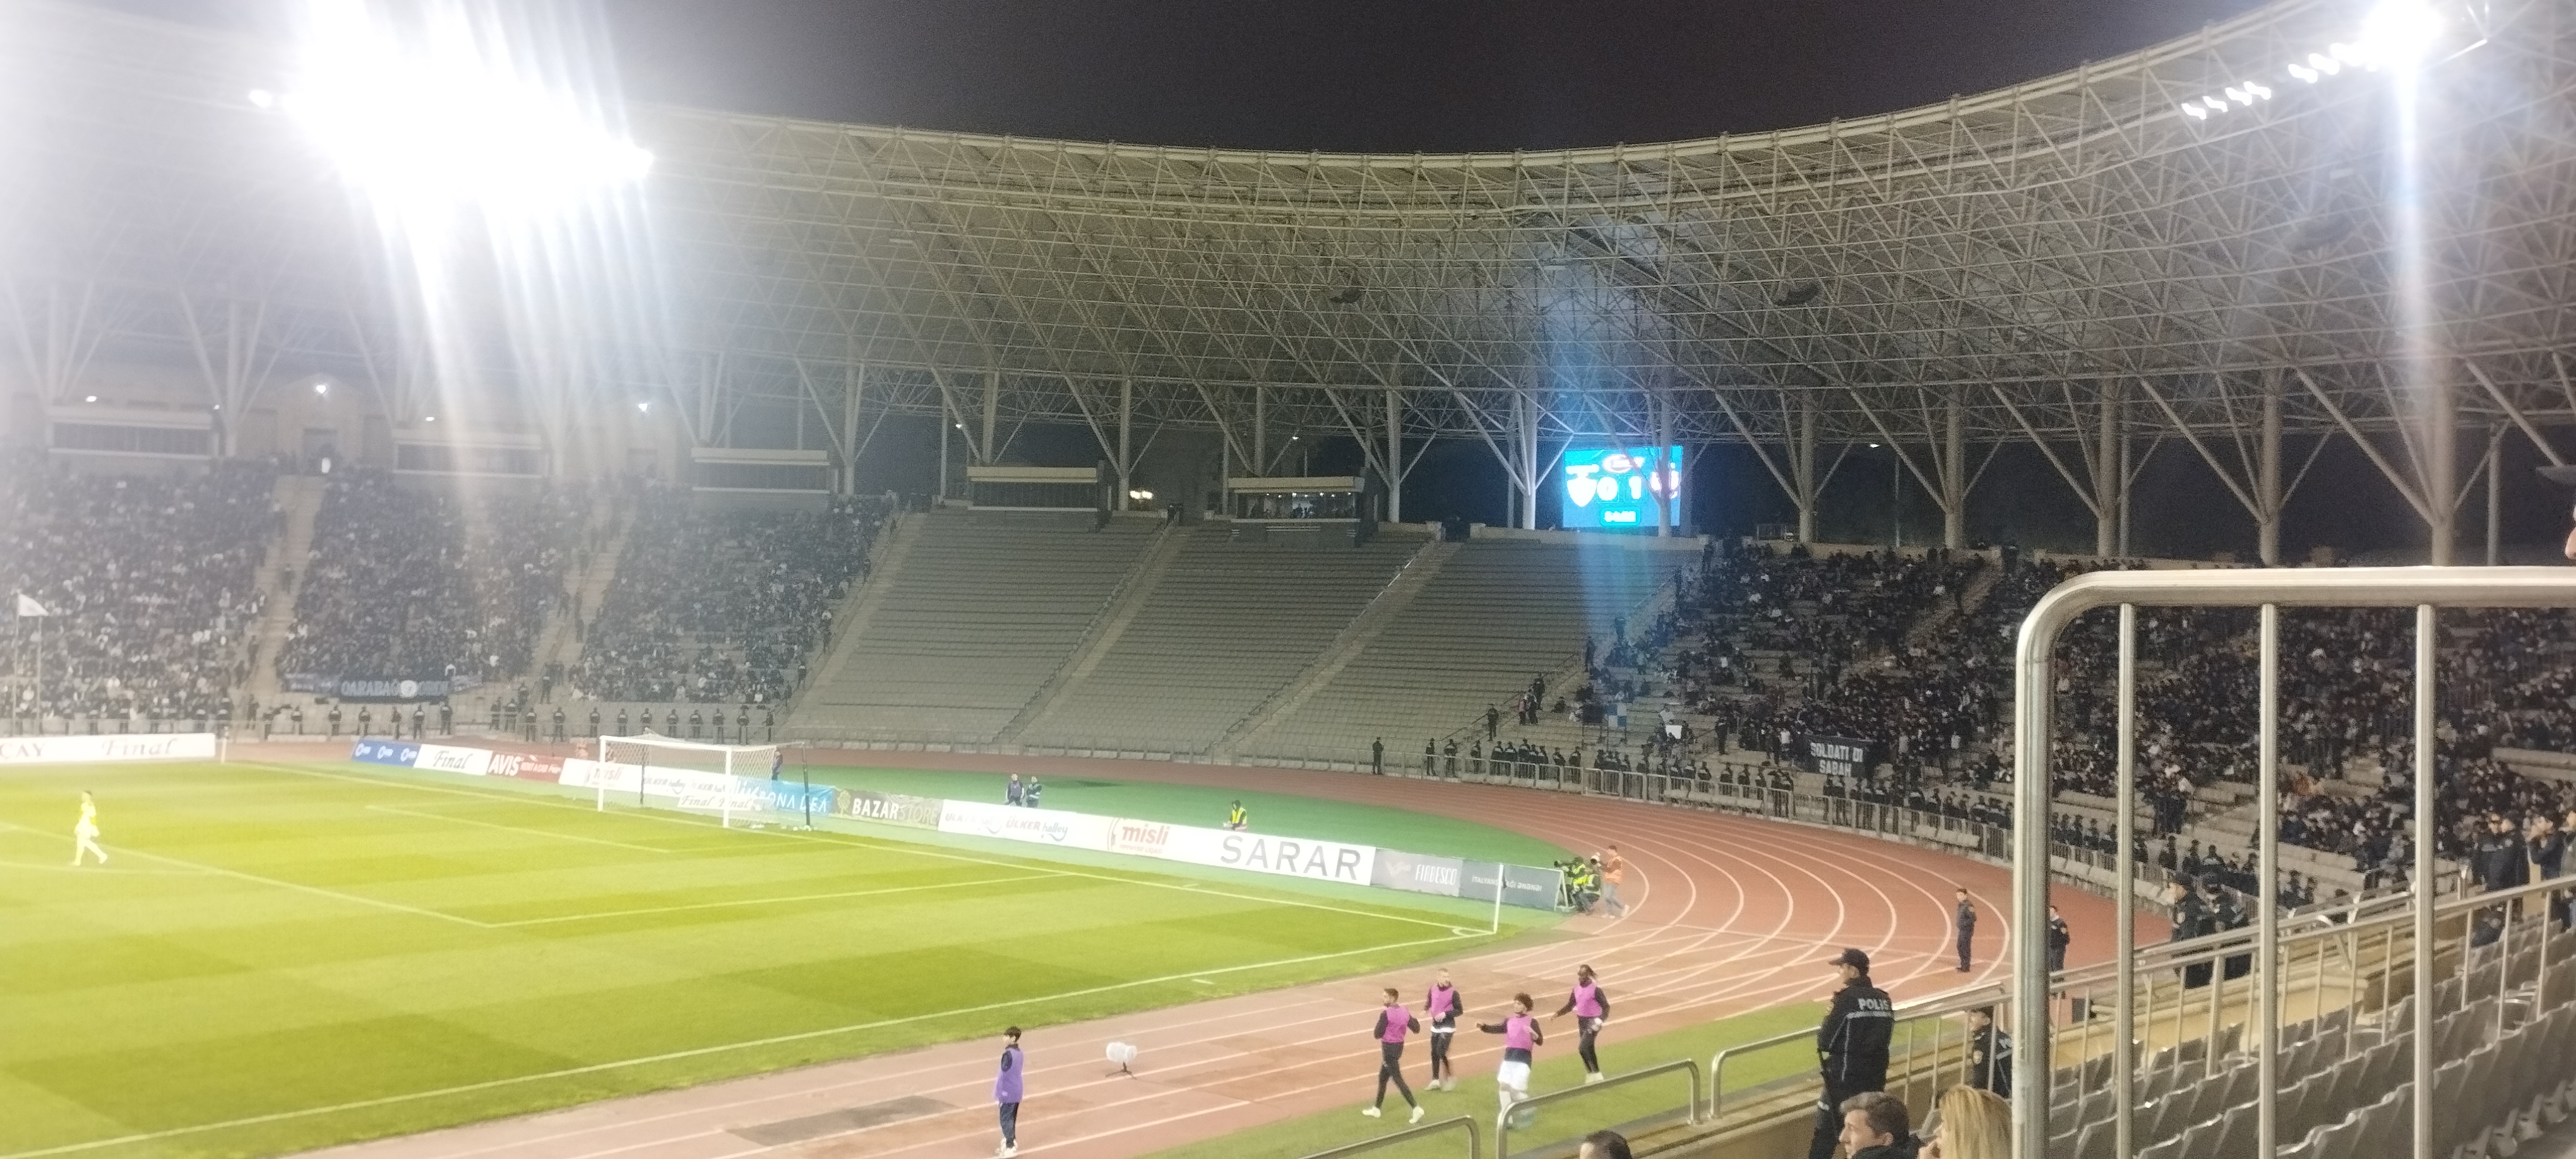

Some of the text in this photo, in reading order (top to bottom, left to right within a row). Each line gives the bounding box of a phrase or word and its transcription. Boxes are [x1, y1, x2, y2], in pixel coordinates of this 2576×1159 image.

[1597, 476, 1642, 501] 0 1
[101, 739, 177, 756] Final
[1810, 742, 1849, 760] SOLDATI
[433, 750, 473, 769] Final
[487, 754, 521, 776] AVIS
[1819, 759, 1852, 777] SABAH
[681, 795, 715, 806] Final
[1006, 815, 1068, 838] ÜLKER halley
[1122, 823, 1171, 845] misli
[1220, 835, 1361, 880] SARAR
[1415, 864, 1458, 886] FIABESCO
[1858, 997, 1889, 1010] POLIS
